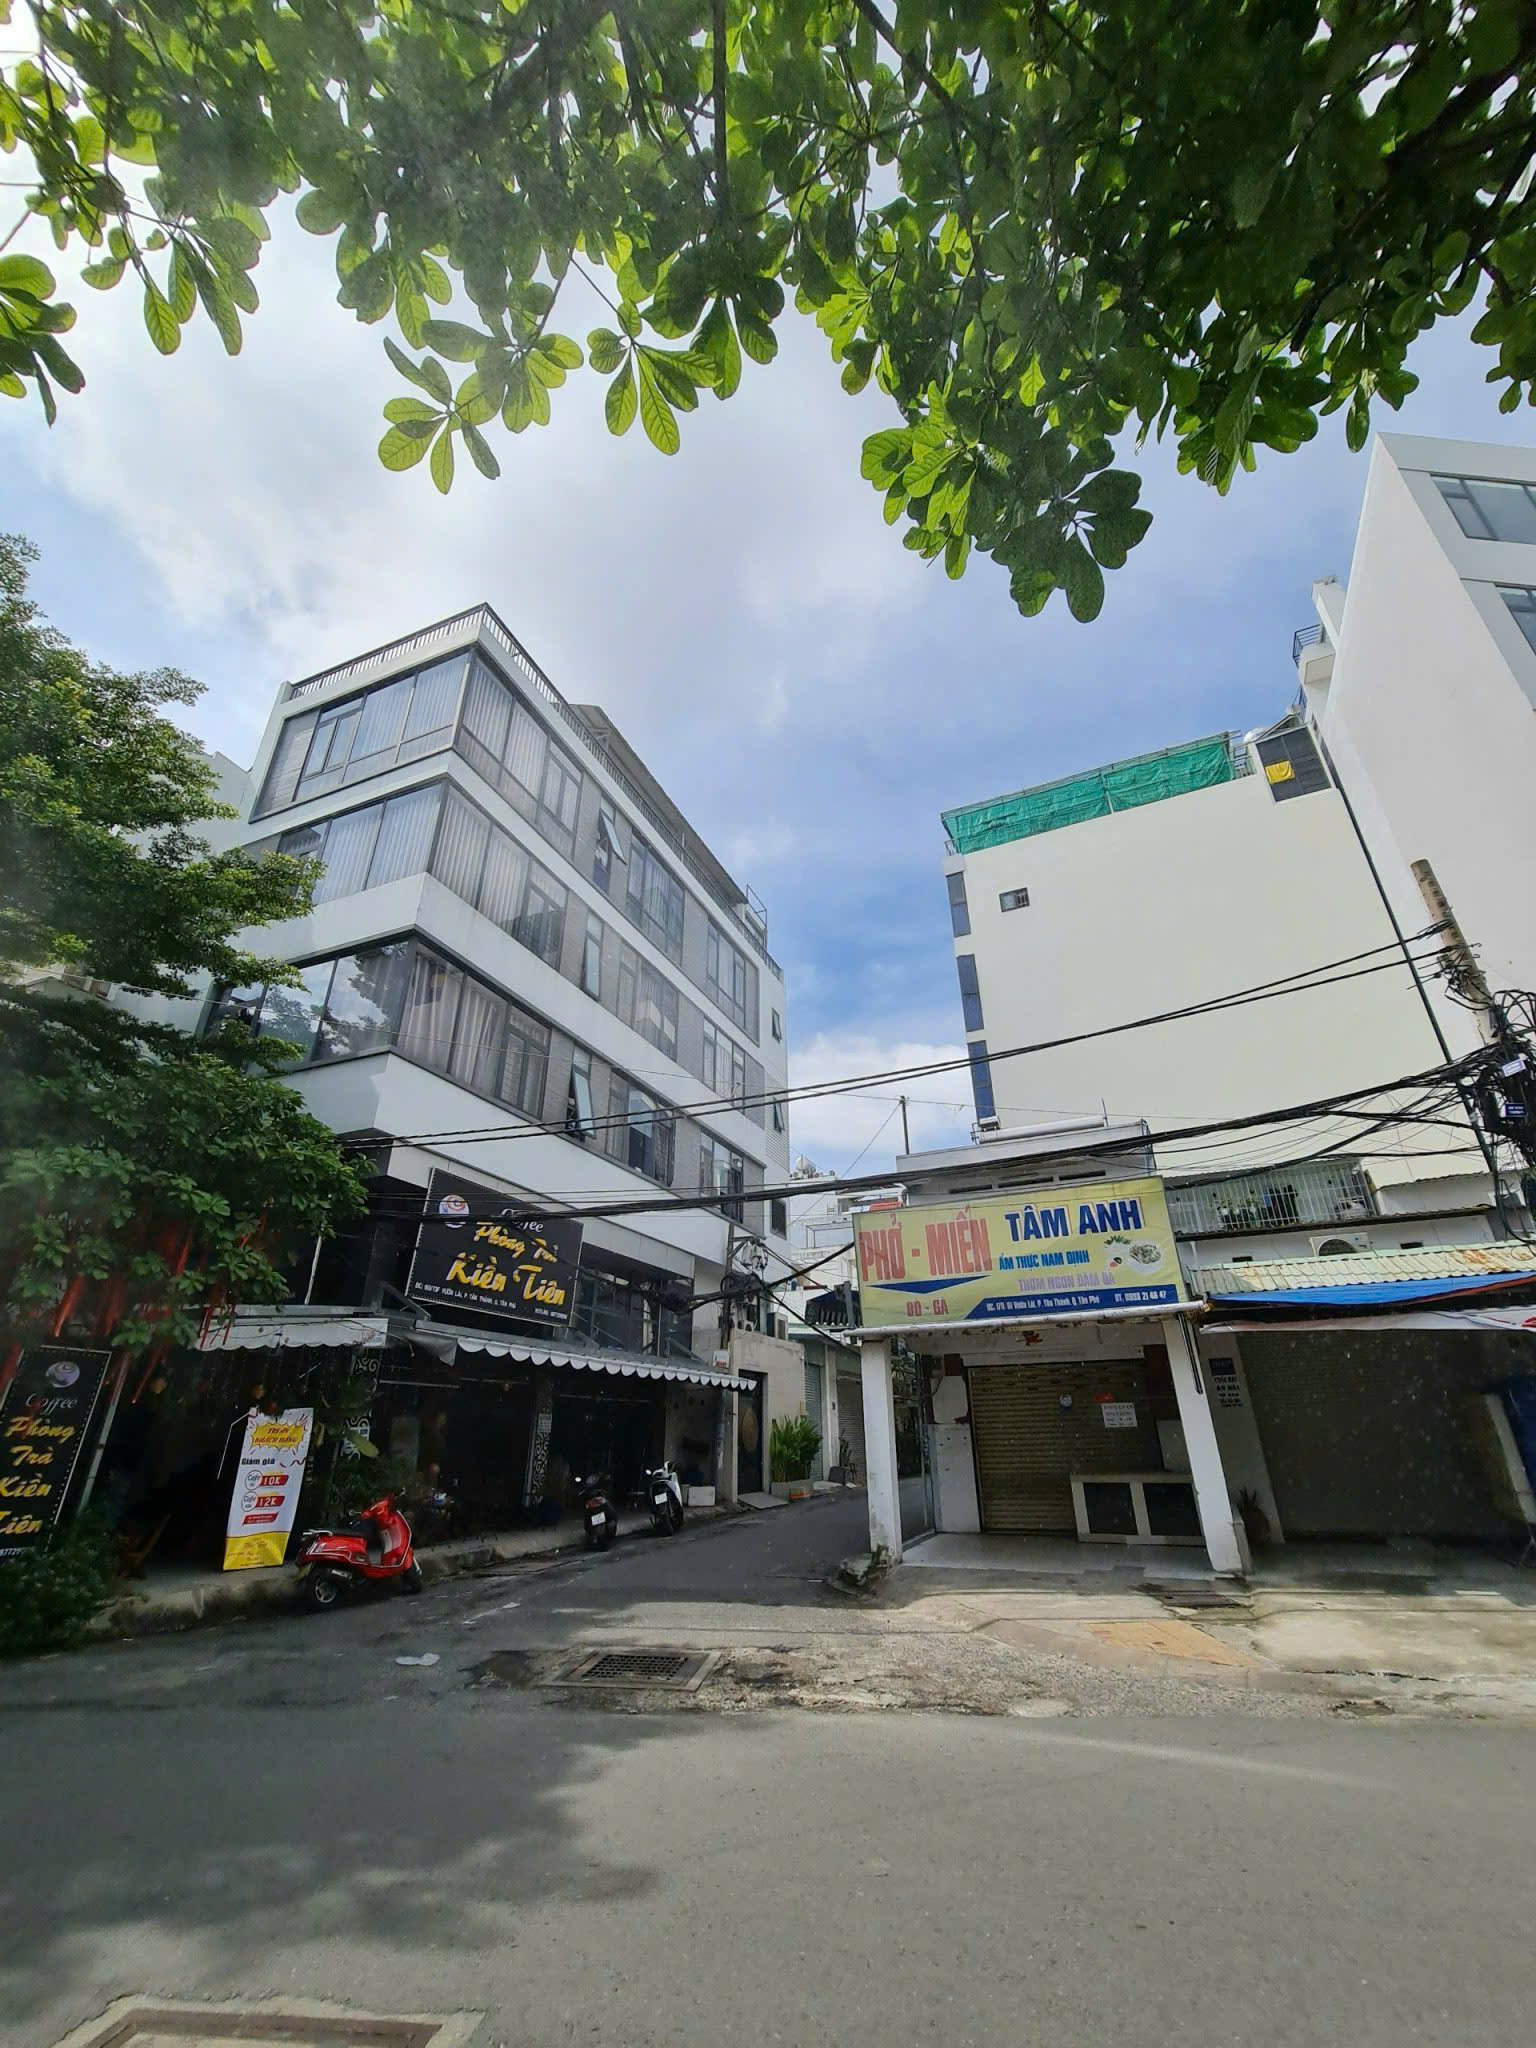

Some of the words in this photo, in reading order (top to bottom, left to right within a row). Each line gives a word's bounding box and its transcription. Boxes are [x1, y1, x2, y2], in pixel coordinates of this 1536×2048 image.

[473, 1221, 526, 1259] Phòng
[1005, 1205, 1070, 1241] TÂM
[1079, 1199, 1143, 1235] ANH
[858, 1212, 906, 1282] PHỞ
[924, 1204, 993, 1276] MIẾN
[1015, 1254, 1040, 1271] THỰC
[1041, 1252, 1065, 1267] NAM
[446, 1252, 508, 1292] Kiền
[512, 1264, 566, 1306] Tiên
[264, 1476, 281, 1485] 10K
